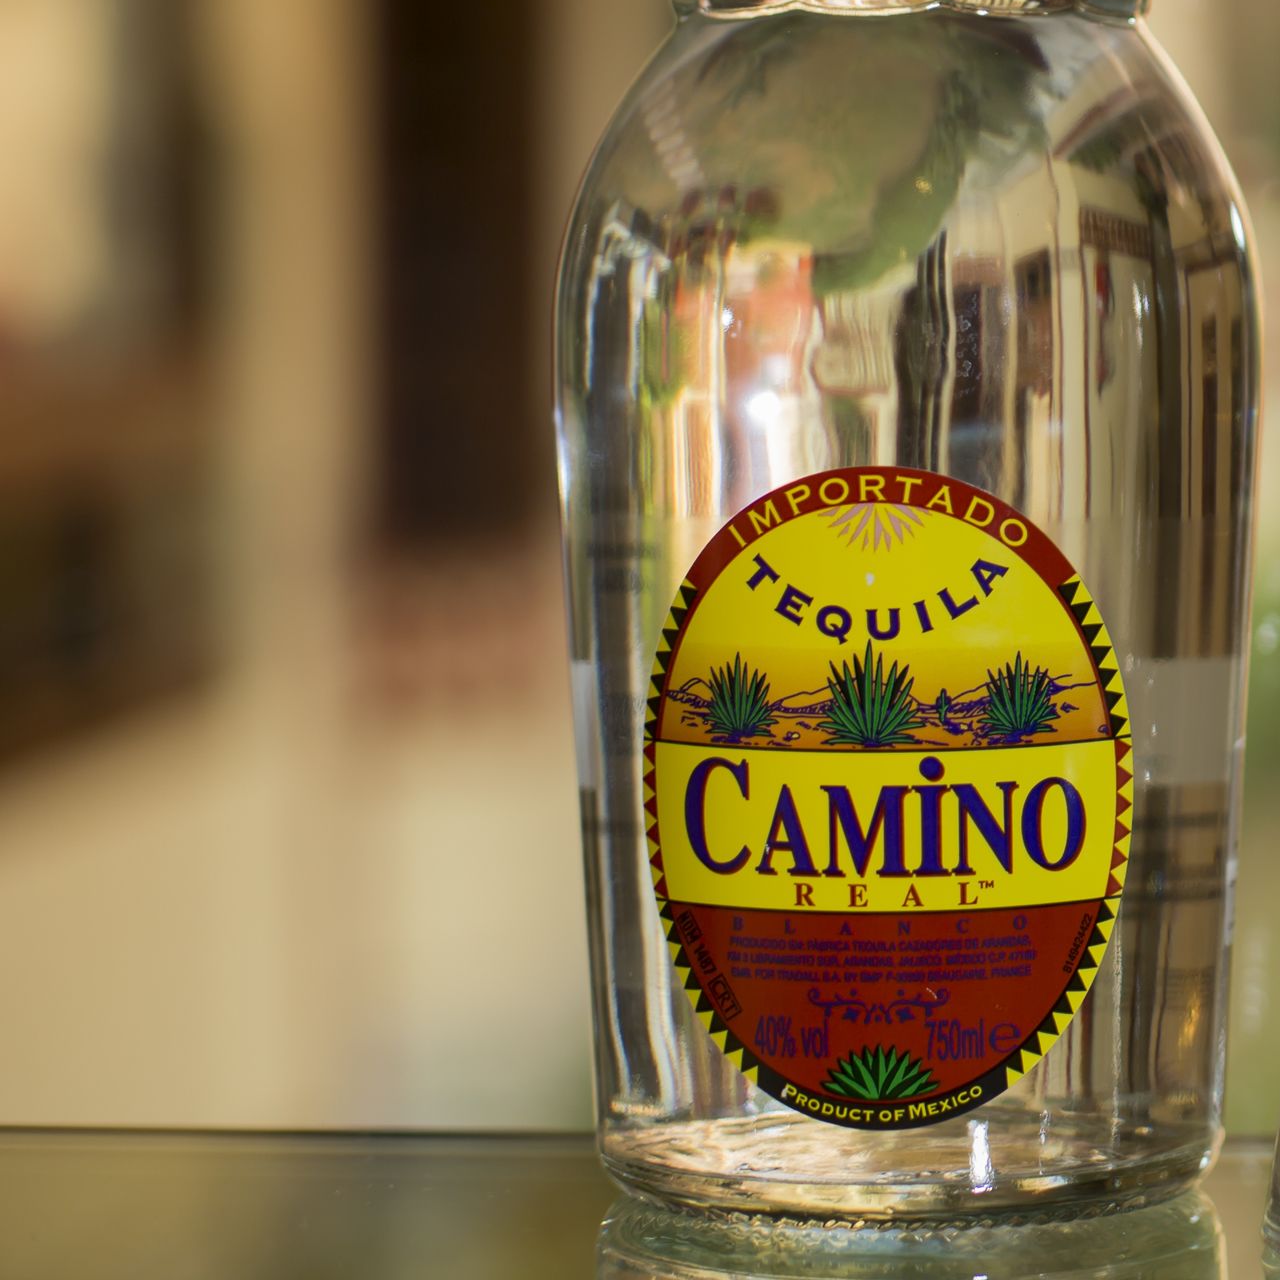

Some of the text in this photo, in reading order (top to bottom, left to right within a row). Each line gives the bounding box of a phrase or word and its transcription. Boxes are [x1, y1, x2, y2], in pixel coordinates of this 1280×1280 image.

[729, 475, 1028, 548] IMPORTADO
[746, 554, 1009, 644] TEQUILA
[684, 756, 1088, 877] CAMINO
[733, 915, 1027, 935] BLANCO
[711, 981, 737, 1015] CRT
[754, 1015, 829, 1059] 40% vol
[924, 1017, 985, 1061] 750ml
[782, 1083, 983, 1122] PRODUCT OF MEXICO
